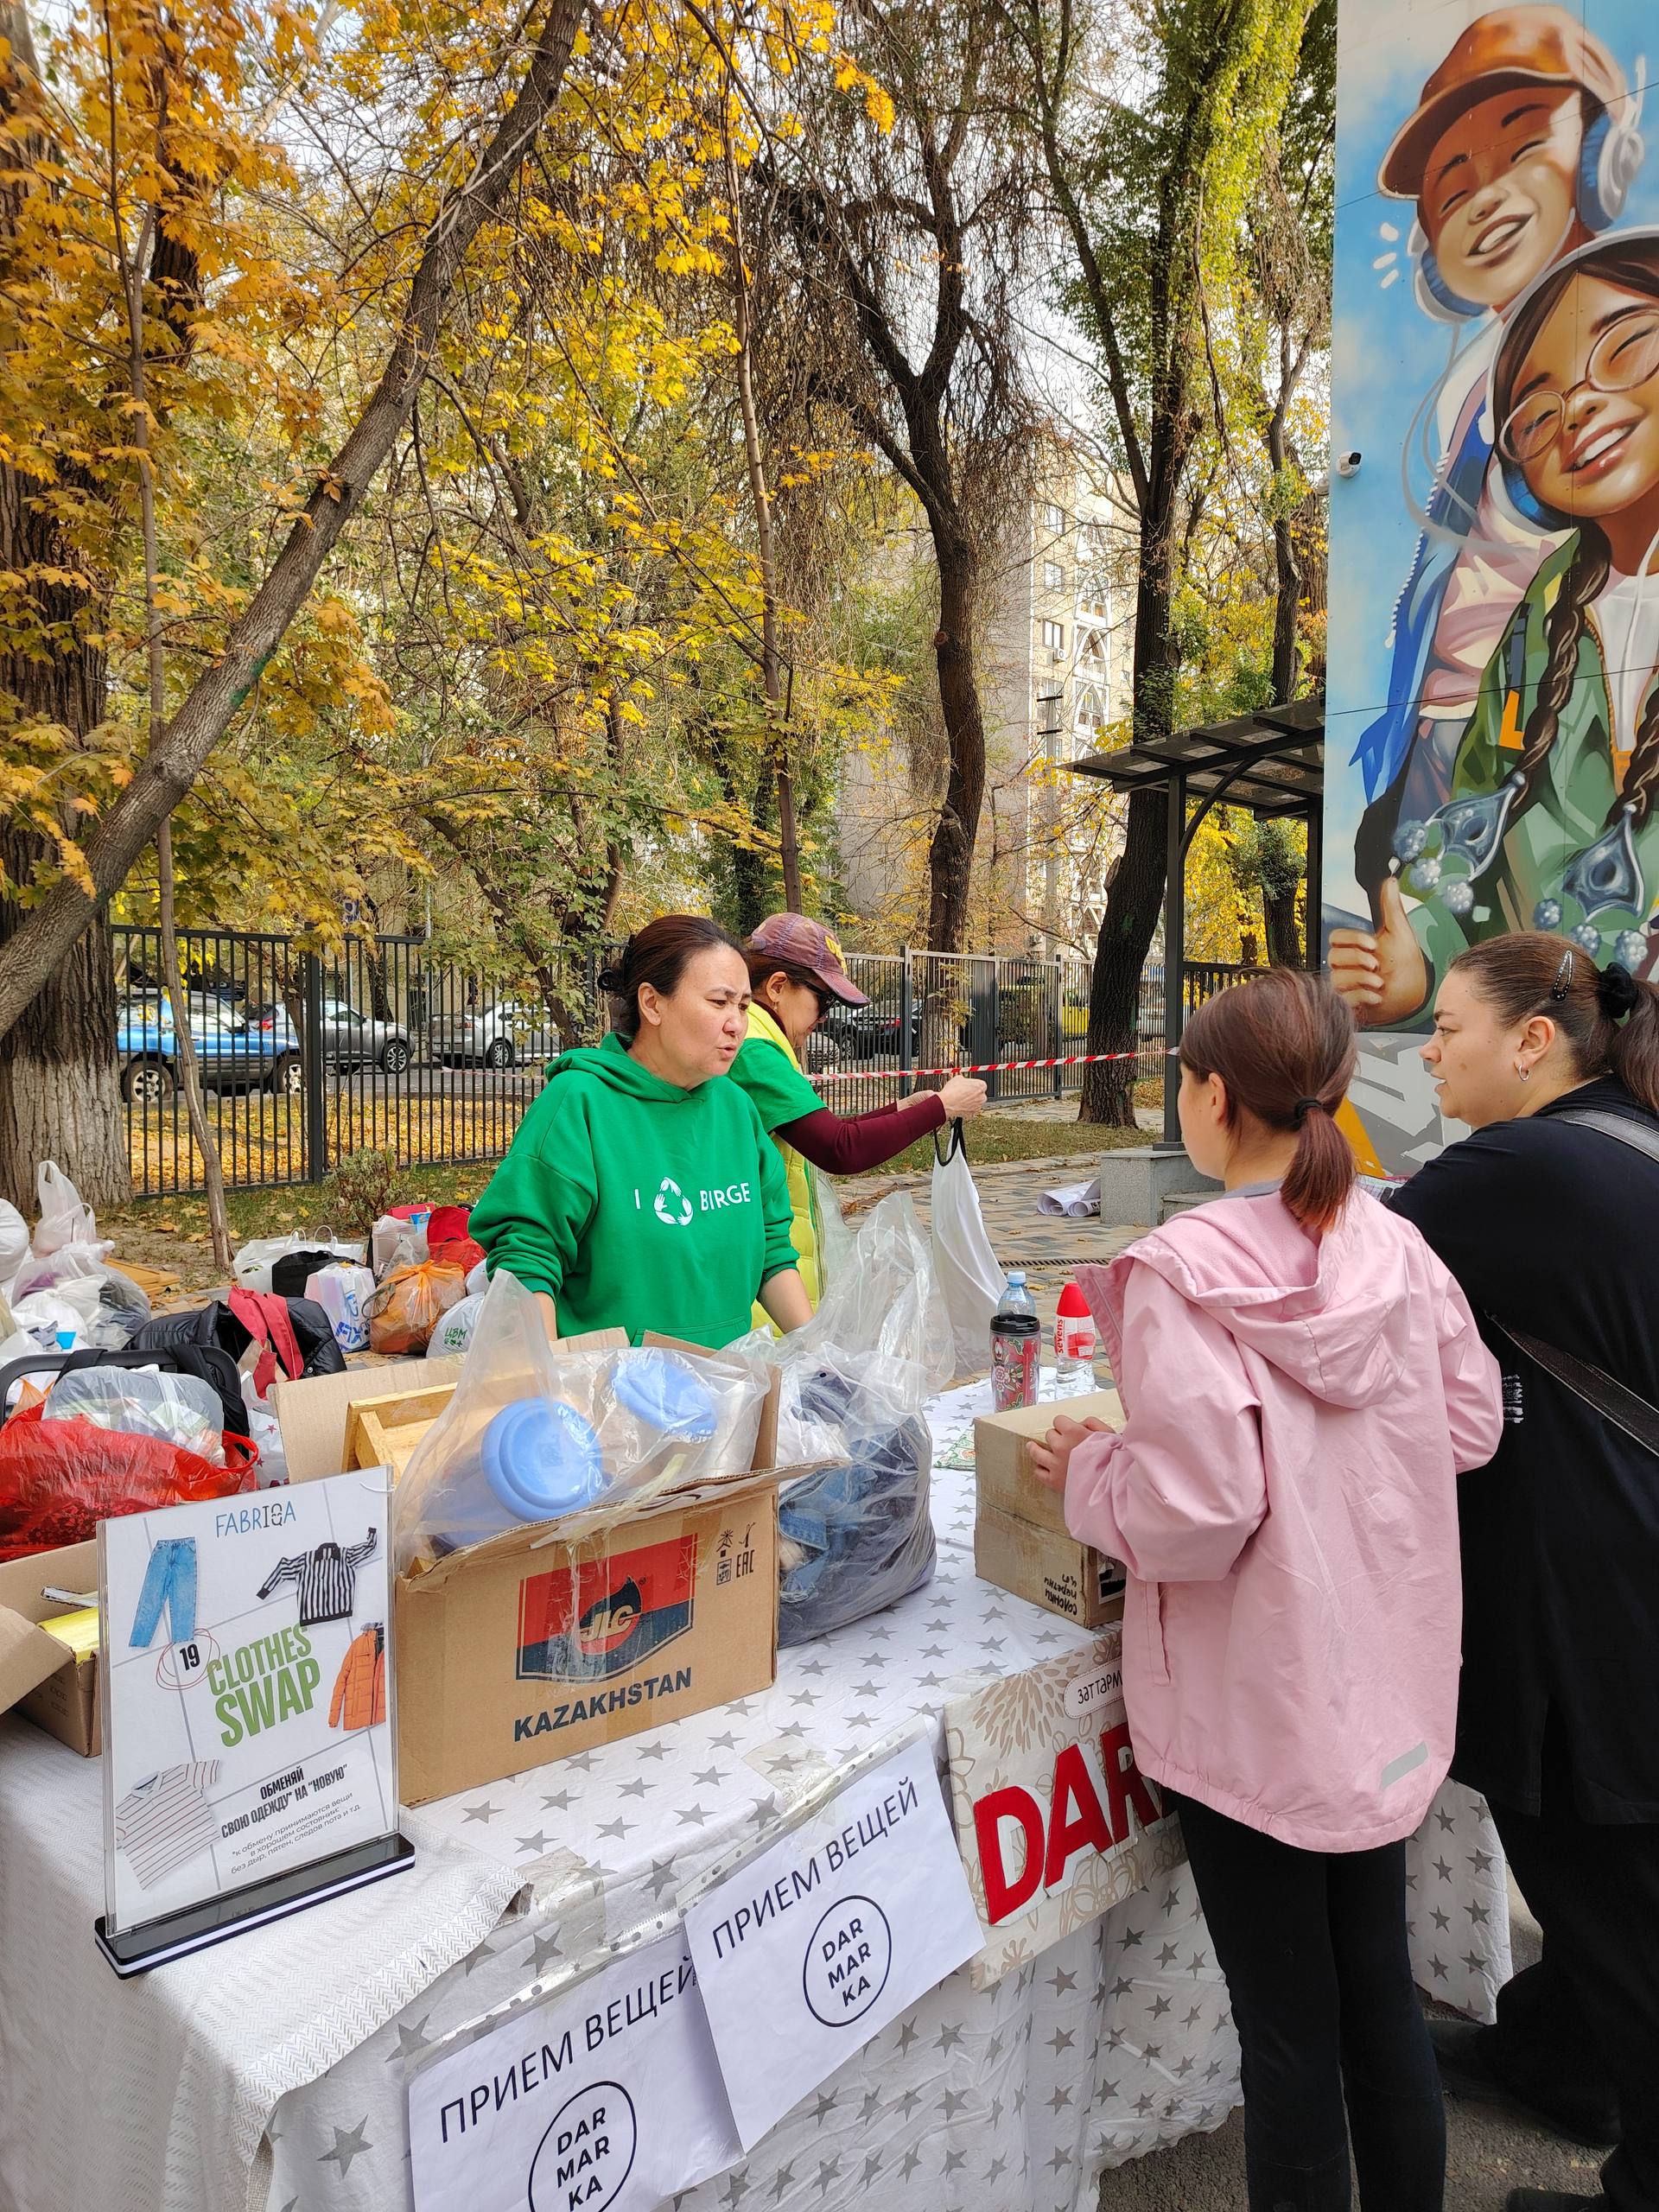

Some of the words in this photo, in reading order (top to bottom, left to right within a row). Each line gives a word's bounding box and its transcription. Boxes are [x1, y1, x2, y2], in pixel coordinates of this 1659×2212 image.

[633, 1188, 641, 1210] I
[699, 1182, 752, 1211] BIRGE
[1056, 1319, 1065, 1354] sevens
[215, 1500, 296, 1538] FABRIQA
[735, 1548, 755, 1579] EAC
[180, 1643, 200, 1671] 19
[207, 1623, 312, 1696] CLOTHES
[215, 1657, 321, 1748] SWAP
[513, 1666, 692, 1743] KAZAKHSTAN
[260, 1765, 305, 1800] ОБМЕНЯЙ
[221, 1813, 251, 1839] СВОЮ
[295, 1784, 308, 1802] НА
[241, 1833, 274, 1853] обмену
[275, 1803, 331, 1836] принимаются
[331, 1792, 353, 1808] вещи
[231, 1862, 246, 1874] без
[295, 1823, 323, 1841] следов
[324, 1813, 342, 1827] пота
[257, 1830, 295, 1853] хорошем
[712, 1858, 821, 1960] ПРИЕМ
[826, 1776, 919, 1872] ВЕЩЕЙ
[821, 1917, 864, 1963] DAR
[827, 1942, 872, 1990] MAR
[842, 1974, 871, 2007] KA
[439, 2031, 574, 2144] ПРИЕМ
[557, 2107, 606, 2157] DAR
[556, 2135, 611, 2189] MAR
[568, 2175, 603, 2212] KA
